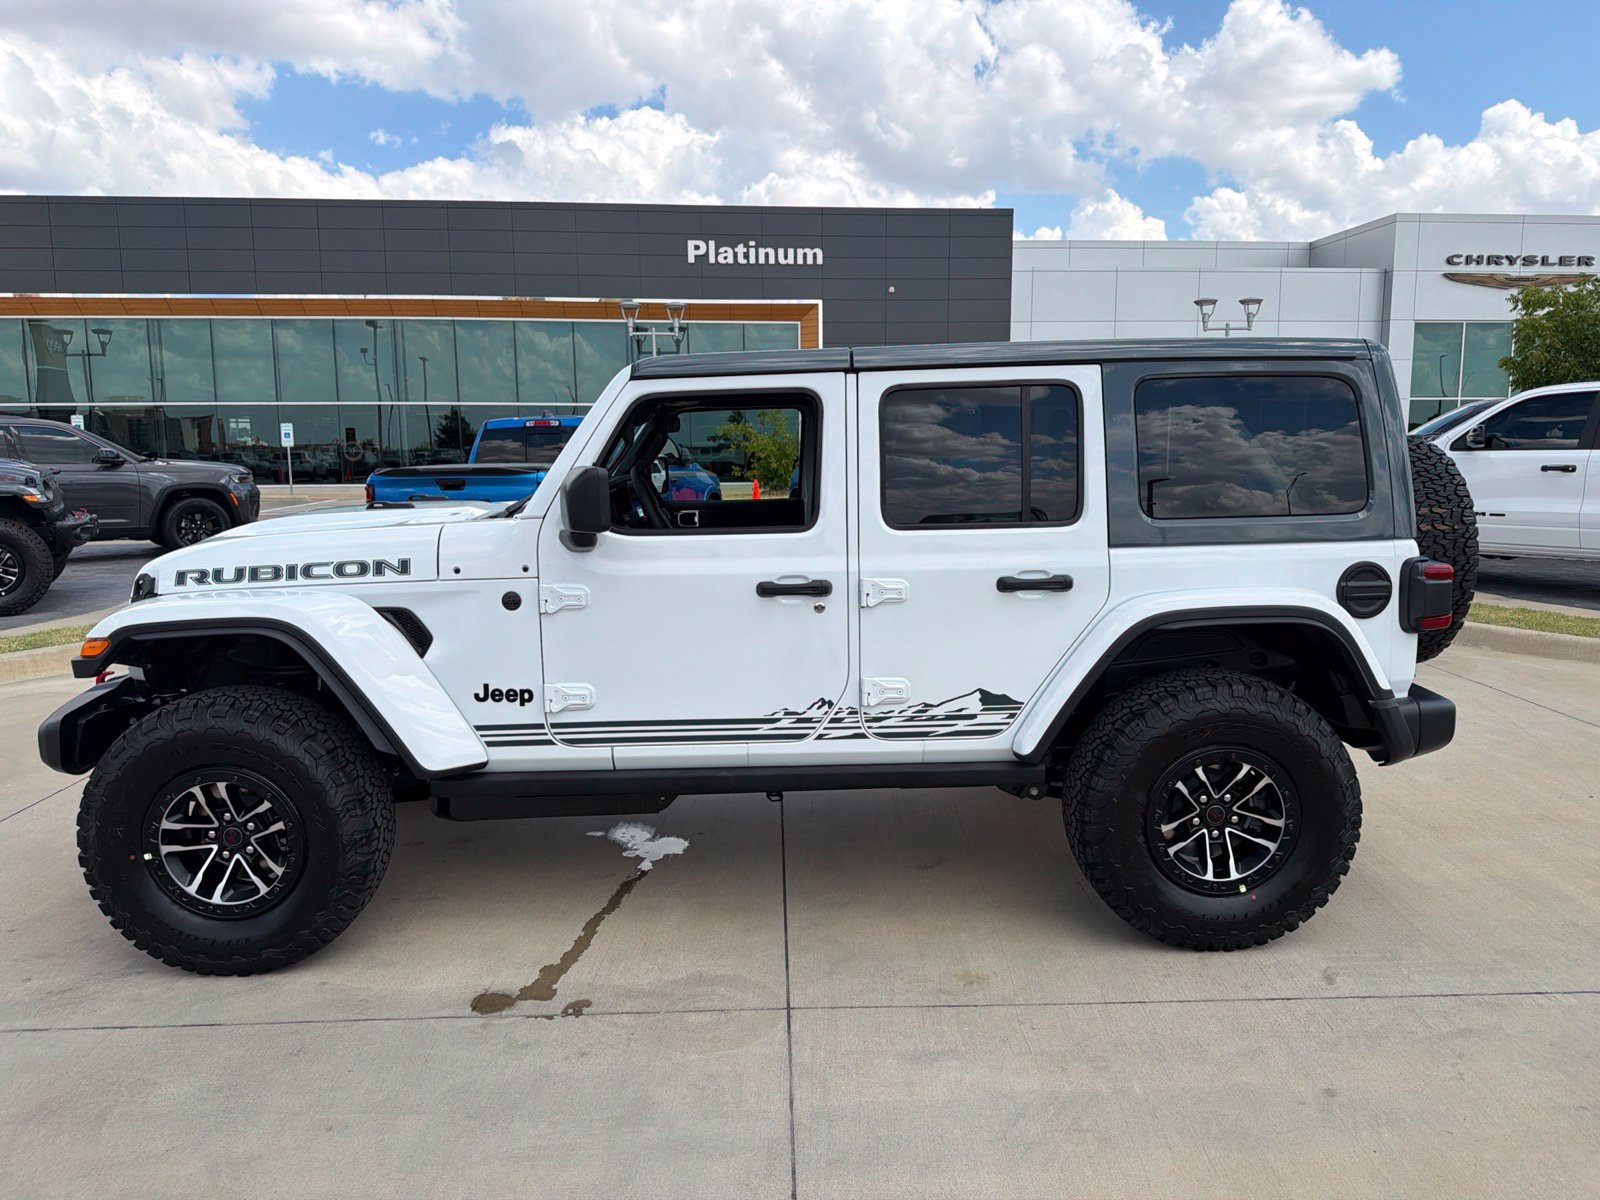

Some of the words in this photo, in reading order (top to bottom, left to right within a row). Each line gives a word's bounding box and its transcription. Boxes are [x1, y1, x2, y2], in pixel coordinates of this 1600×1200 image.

[687, 239, 824, 265] Platinum
[1446, 253, 1596, 267] CHRYSLER
[174, 557, 411, 587] RUBICON
[473, 683, 534, 707] Jeep
